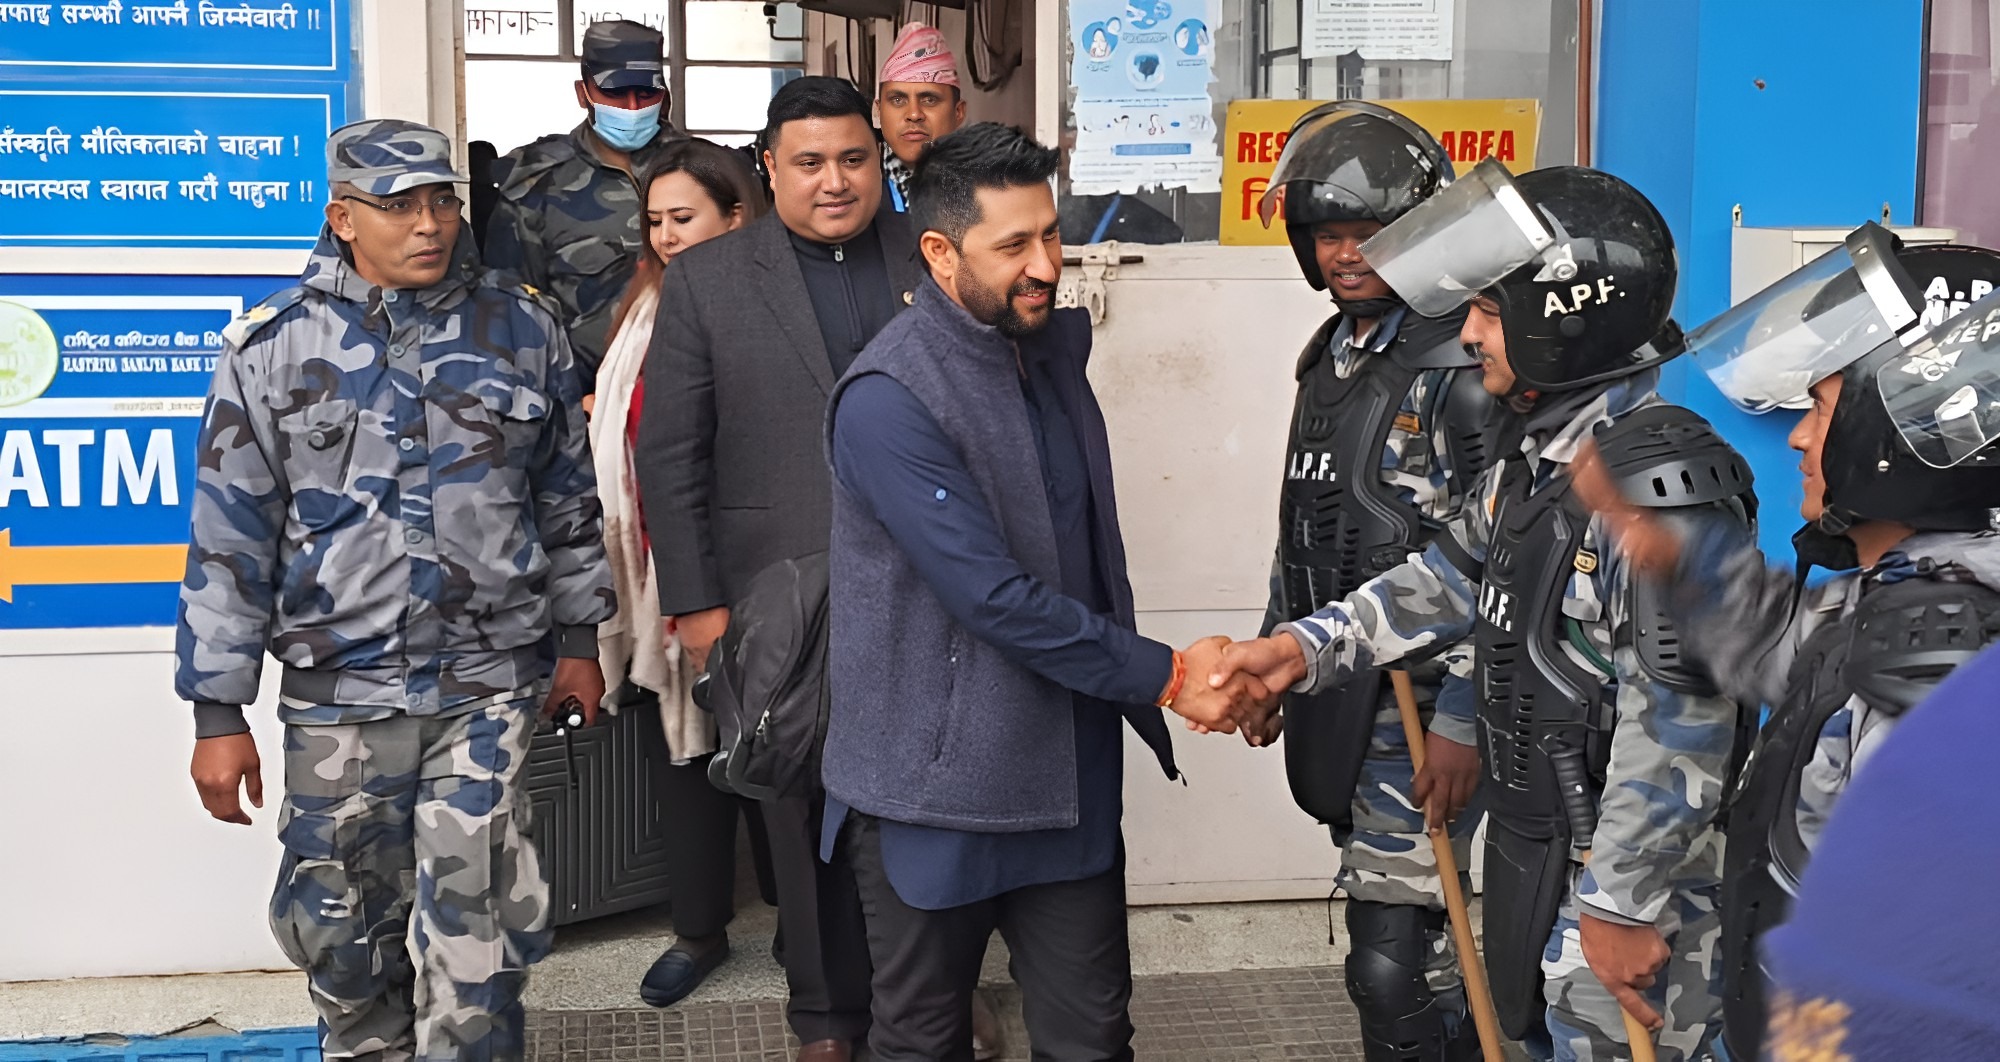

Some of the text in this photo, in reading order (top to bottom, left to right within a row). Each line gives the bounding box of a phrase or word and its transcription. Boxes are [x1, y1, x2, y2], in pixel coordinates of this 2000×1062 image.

[198, 0, 299, 30] जिम्मेवारी
[80, 125, 209, 155] मौलिकताको
[217, 135, 284, 160] चाहना
[1237, 130, 1515, 163] RES AREA
[100, 180, 170, 201] स्वागत
[227, 181, 290, 209] पाहुना
[1923, 276, 1996, 303] A.P
[0, 428, 180, 508] ATM
